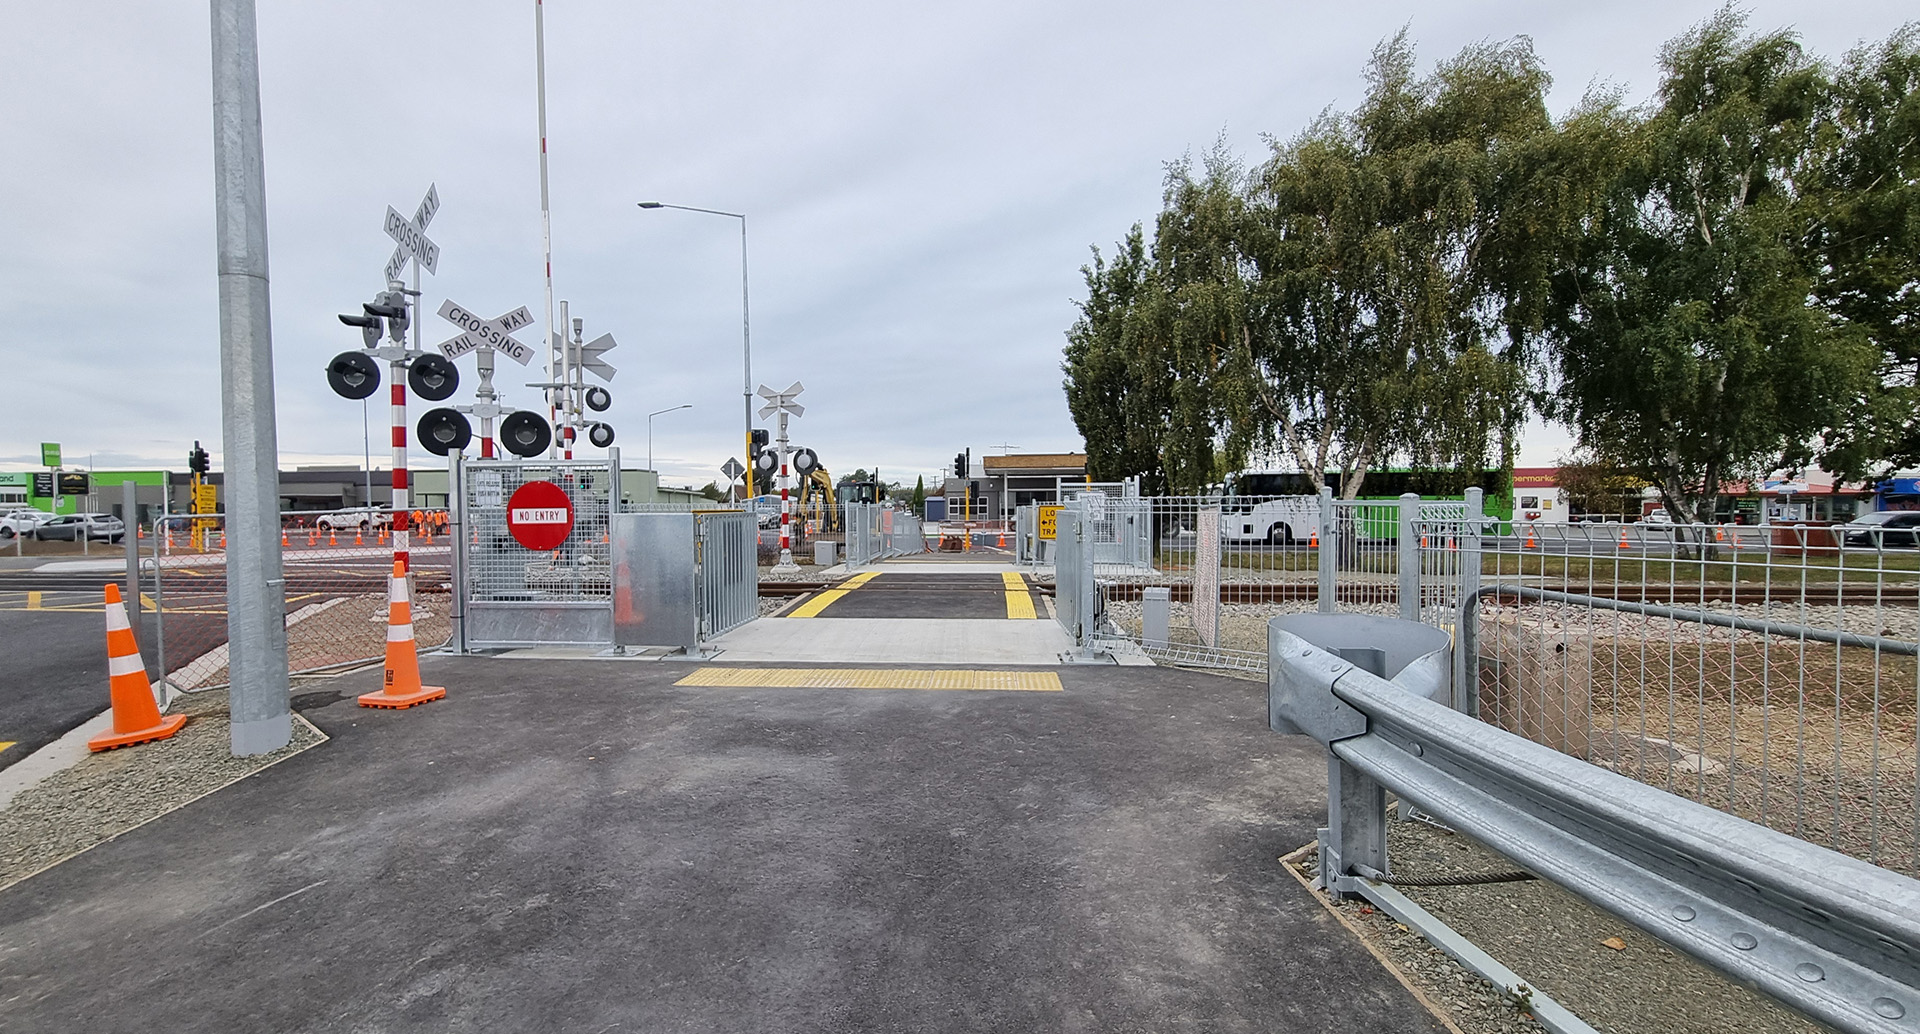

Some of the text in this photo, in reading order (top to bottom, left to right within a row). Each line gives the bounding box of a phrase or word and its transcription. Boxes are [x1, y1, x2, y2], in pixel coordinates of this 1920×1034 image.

[386, 190, 436, 281] RAIL WAY
[388, 212, 434, 267] CROSSING
[443, 310, 527, 358] RAIL WAY
[449, 307, 525, 359] CROSSING
[519, 510, 560, 521] NO ENTRY
